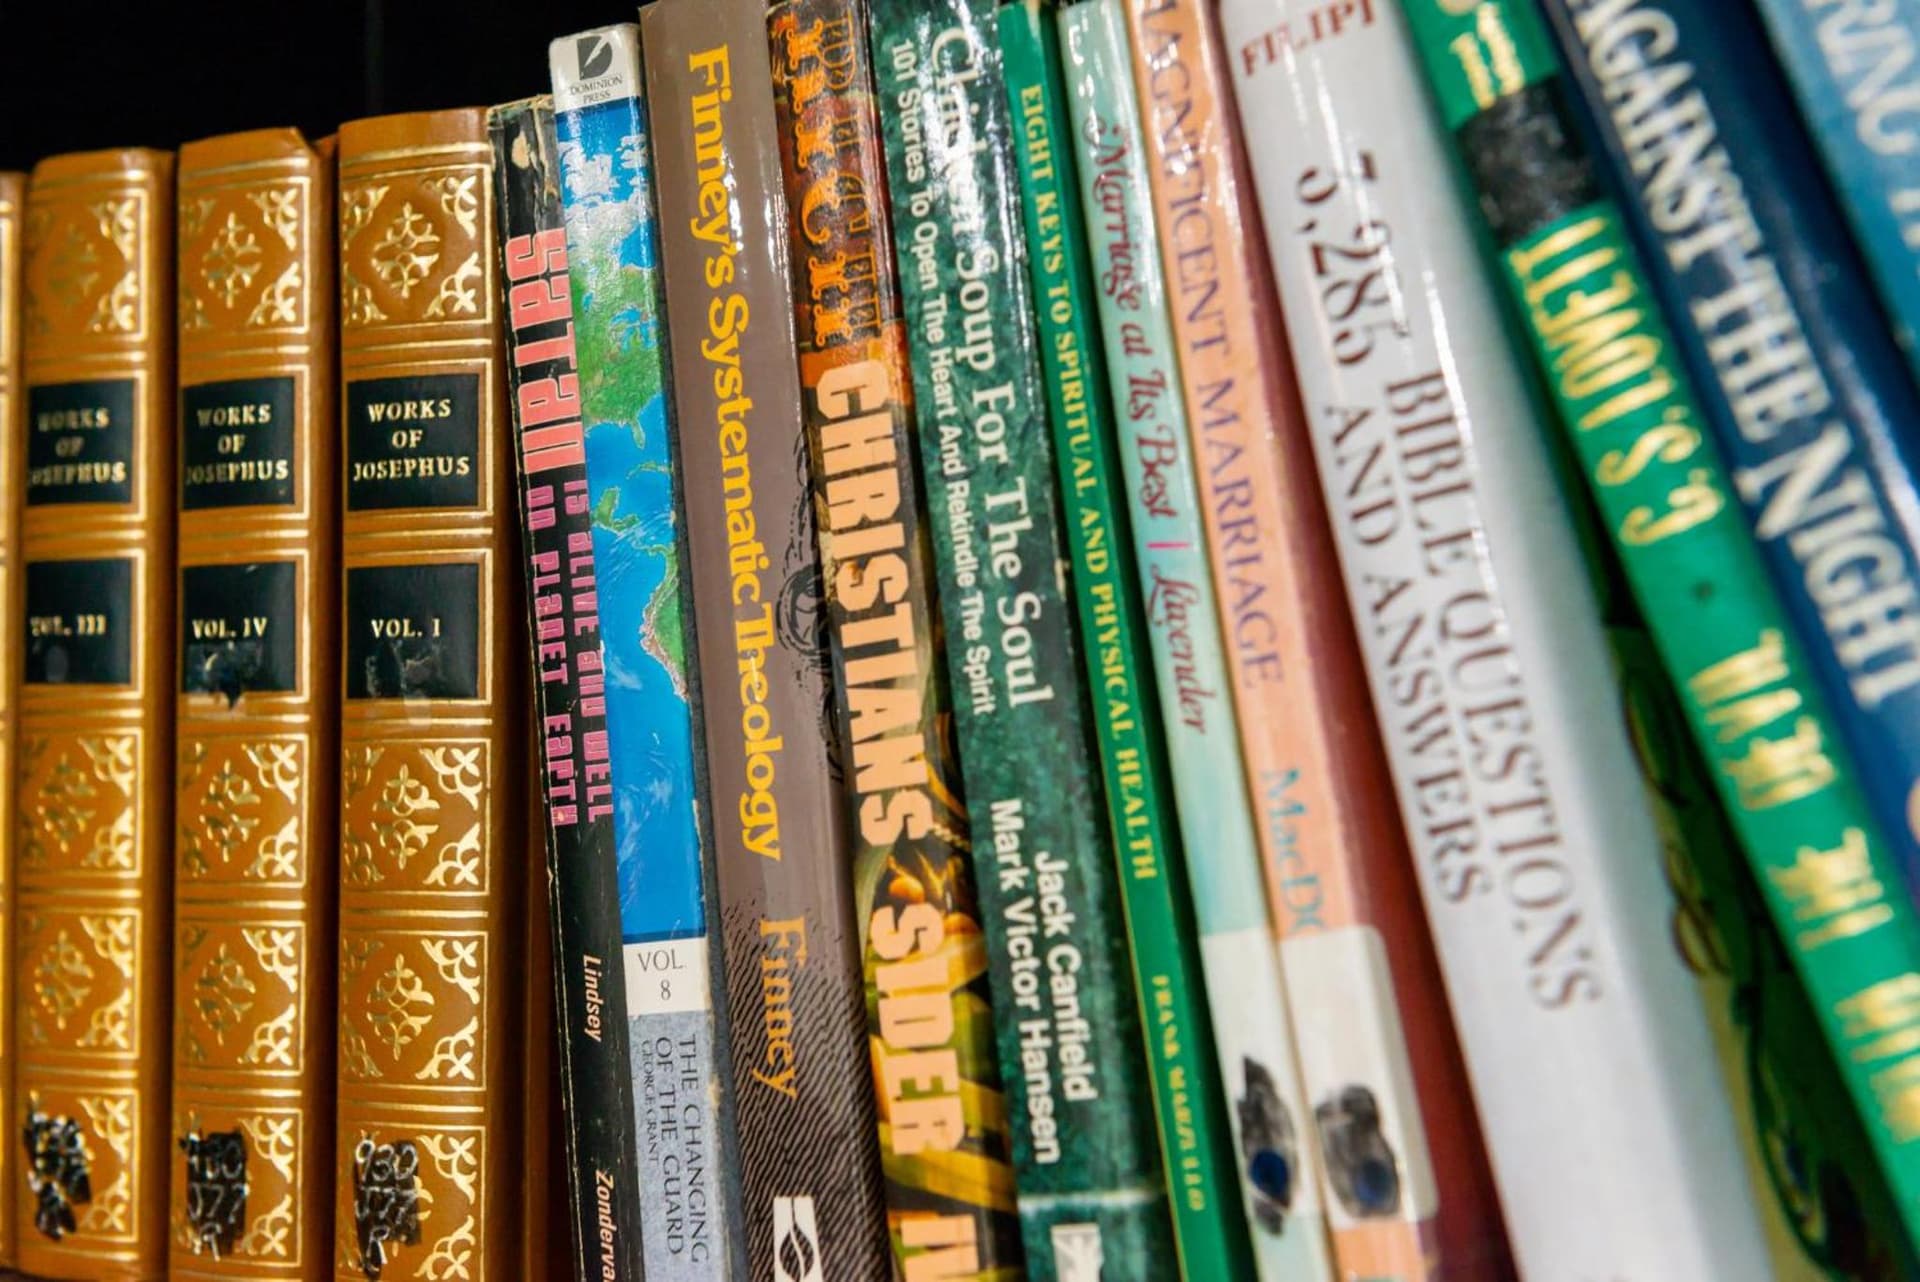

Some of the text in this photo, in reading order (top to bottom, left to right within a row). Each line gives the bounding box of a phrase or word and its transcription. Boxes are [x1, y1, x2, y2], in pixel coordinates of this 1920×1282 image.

[568, 72, 623, 95] DOMINION
[583, 90, 611, 104] PRESS
[955, 245, 999, 372] Soup
[1082, 115, 1177, 519] Marriage at Its Best
[1508, 215, 1677, 433] LOVETT
[1692, 254, 1832, 444] THE
[38, 407, 111, 432] WORKS
[197, 403, 272, 426] WORKS
[368, 398, 453, 423] WORKS
[786, 16, 934, 848] RICH CHRISTIANS
[892, 38, 997, 716] 101 Stories To Open The Heart And Rekindle The Spirit
[972, 381, 1016, 470] For
[55, 436, 86, 457] OF
[186, 458, 290, 485] JOSEPHUS
[217, 434, 247, 454] OF
[353, 456, 471, 482] JOSEPHUS
[392, 428, 424, 449] OF
[689, 44, 783, 862] Finney's Systematic Theology
[1020, 84, 1158, 880] EIGHT KEYS TO SPIRITUAL AND PHYSICAL HEALTH
[984, 475, 1033, 578] The
[1196, 377, 1284, 688] MARRIAGE
[1731, 422, 1920, 710] NIGHT
[76, 613, 107, 636] III
[191, 617, 268, 639] VOL. IV
[370, 617, 441, 639] VOL. I
[997, 591, 1055, 708] Soul
[1325, 403, 1495, 908] AND ANSWERS
[1385, 371, 1604, 1013] BIBLE QUESTIONS
[583, 954, 603, 1043] Lindsey
[660, 979, 672, 1001] 8
[753, 917, 806, 1101] Finney
[870, 903, 965, 1155] SIDER
[990, 797, 1061, 1163] Mark Victor Hansen
[1034, 850, 1099, 1101] Jack Canfield
[645, 1108, 660, 1163] GRANT
[655, 1036, 685, 1255] OF THE GUARD
[678, 1033, 710, 1264] THE CHANGING
[594, 1169, 619, 1282] Zonderva
